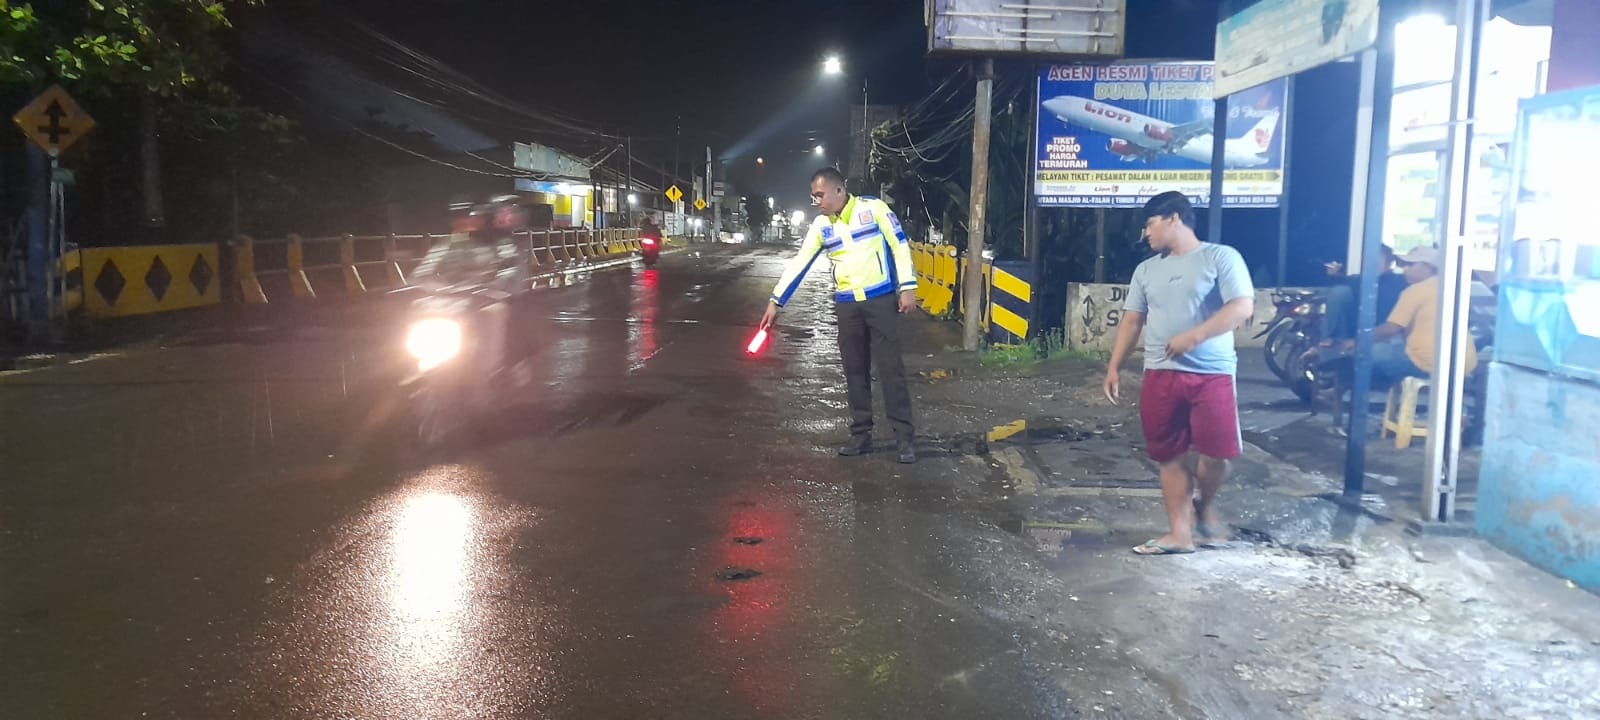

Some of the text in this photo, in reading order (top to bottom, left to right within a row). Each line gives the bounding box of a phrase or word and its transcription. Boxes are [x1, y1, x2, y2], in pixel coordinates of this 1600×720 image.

[1048, 65, 1093, 81] AGEN
[1097, 65, 1147, 81] RESMI
[1151, 65, 1198, 81] TIKET
[1046, 144, 1080, 152] PROMO
[1039, 160, 1088, 168] TERMURAH
[1095, 172, 1127, 181] PESAWAT
[1128, 172, 1152, 181] DALAM
